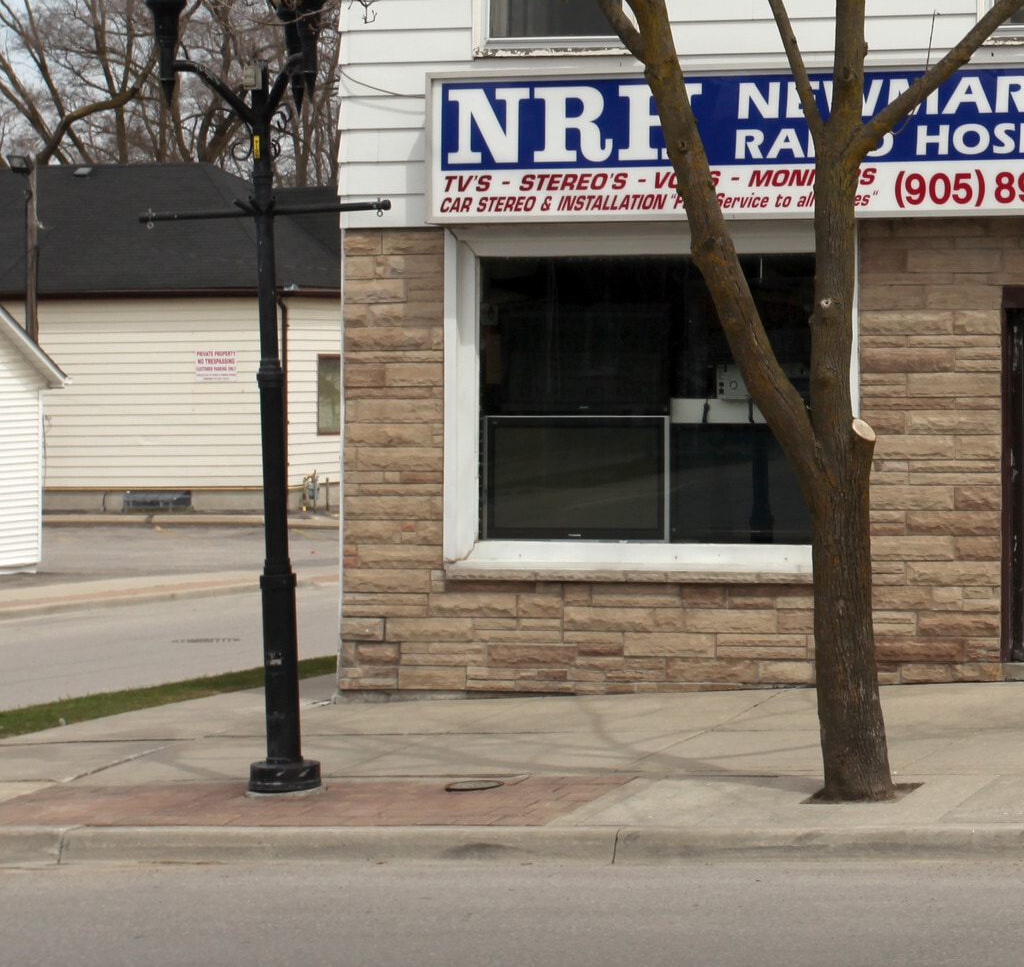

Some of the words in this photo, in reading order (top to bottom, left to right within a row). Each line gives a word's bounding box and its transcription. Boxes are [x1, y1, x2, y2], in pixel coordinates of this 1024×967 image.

[444, 174, 492, 193] TV'S
[519, 172, 629, 191] STEREO'S
[894, 169, 985, 208] (905)
[440, 196, 473, 213] CAR
[476, 196, 537, 212] STEREO
[540, 196, 552, 212] &
[557, 194, 668, 212] INSTALLATION
[716, 192, 769, 209] Service
[775, 193, 792, 208] to
[797, 191, 816, 208] all
